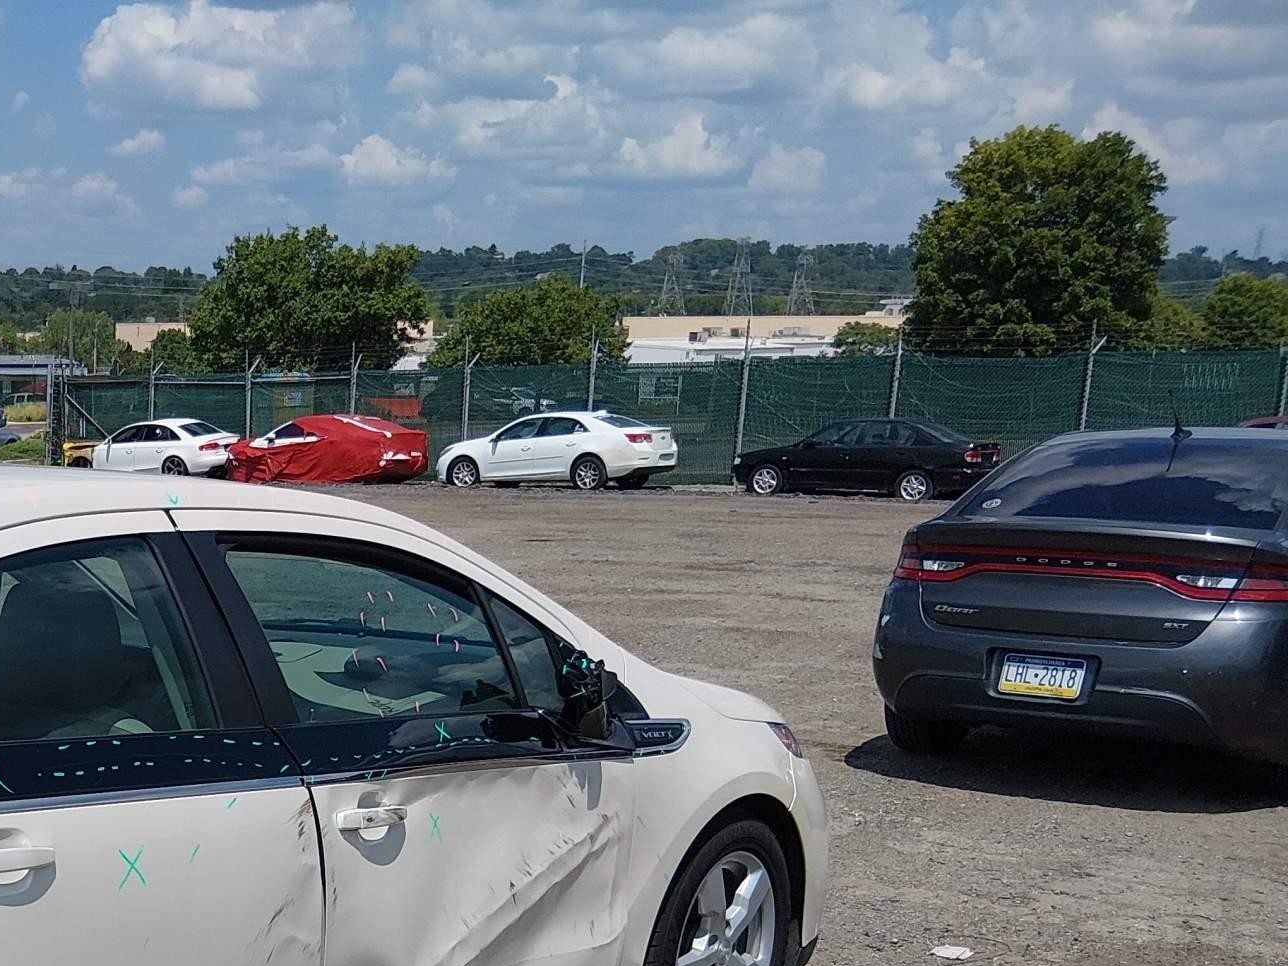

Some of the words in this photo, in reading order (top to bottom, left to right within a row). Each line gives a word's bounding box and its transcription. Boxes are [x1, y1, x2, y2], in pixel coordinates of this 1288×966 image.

[1016, 556, 1118, 567] DODGE
[934, 603, 979, 614] Dart
[1162, 622, 1189, 630] SXT
[642, 730, 666, 738] VOLT
